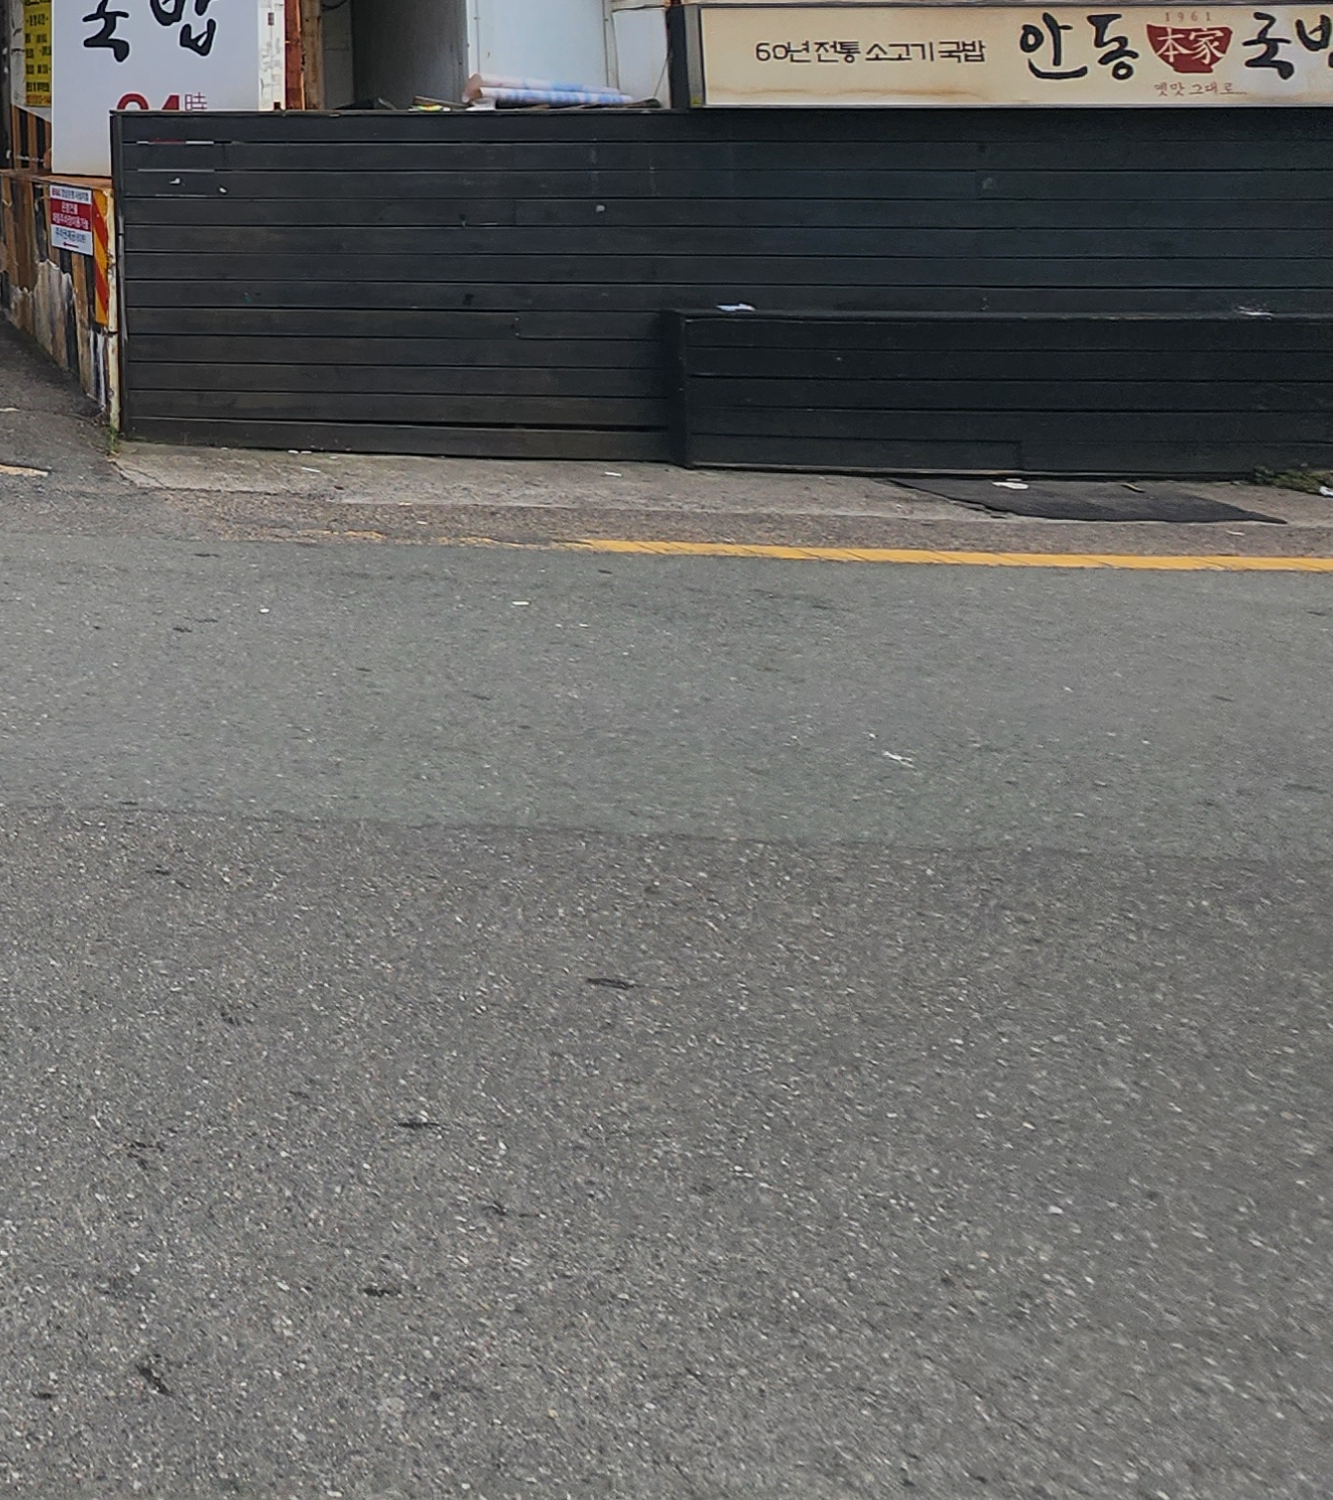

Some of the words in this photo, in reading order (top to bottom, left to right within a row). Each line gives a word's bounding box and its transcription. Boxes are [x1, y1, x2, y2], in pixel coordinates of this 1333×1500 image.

[1164, 11, 1213, 23] 1961
[755, 41, 811, 62] 60년
[814, 40, 861, 63] 전통
[864, 42, 935, 62] 소고기
[937, 40, 987, 63] 국밥
[1020, 12, 1139, 80] 안동
[1155, 27, 1226, 63] 本家
